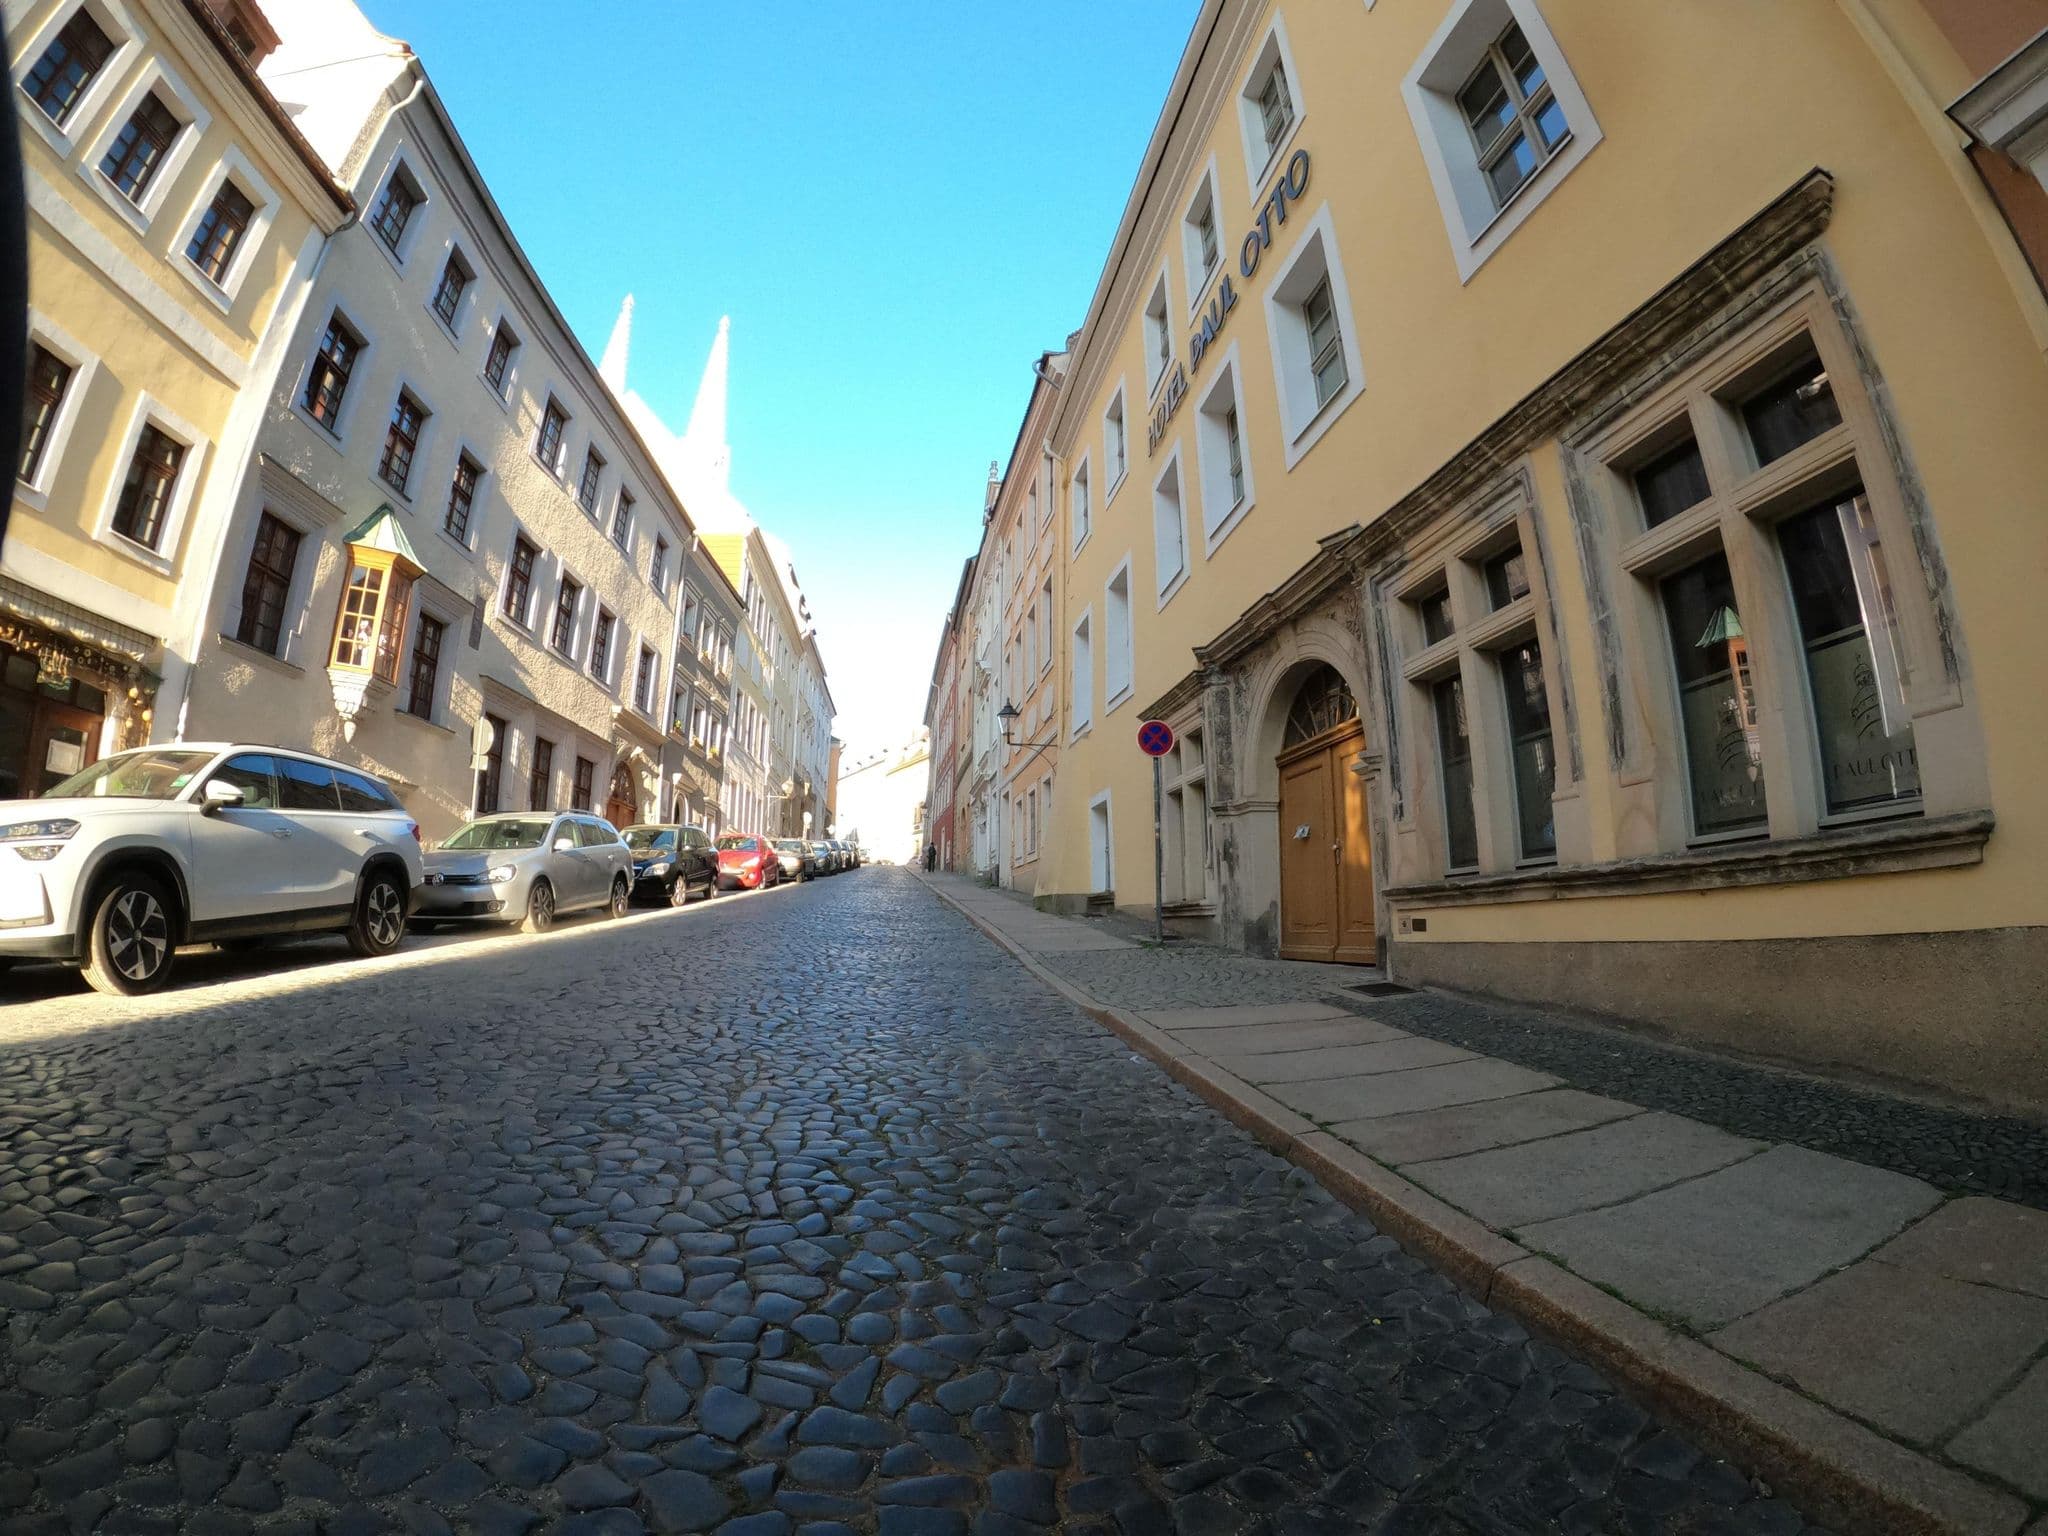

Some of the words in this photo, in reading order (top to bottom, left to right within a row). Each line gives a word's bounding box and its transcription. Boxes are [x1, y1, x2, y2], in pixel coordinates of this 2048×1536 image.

[1148, 361, 1188, 458] HOTEL
[1190, 273, 1238, 375] PAUL
[1240, 149, 1309, 277] OTTO
